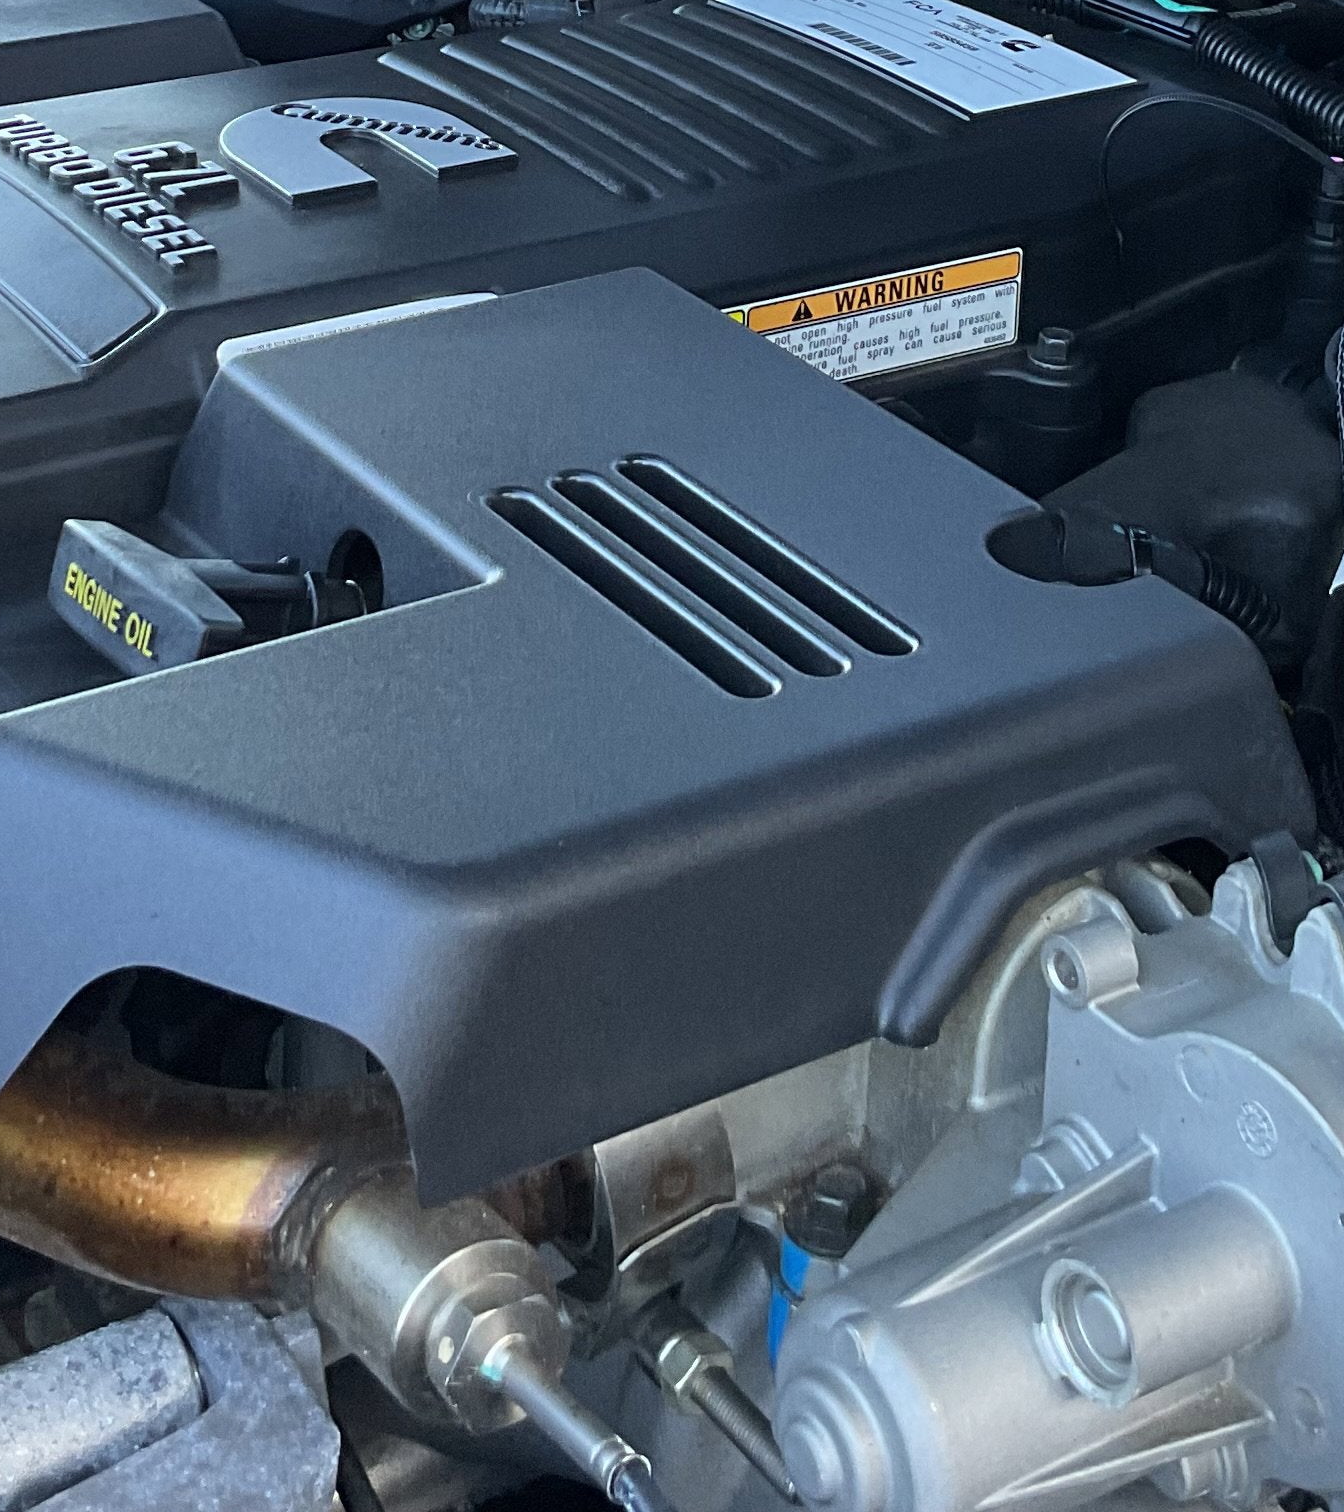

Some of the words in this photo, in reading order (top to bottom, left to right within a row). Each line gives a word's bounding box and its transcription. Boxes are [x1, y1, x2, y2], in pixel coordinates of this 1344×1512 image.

[902, 0, 943, 16] FCA
[270, 101, 506, 151] Cummins
[113, 140, 240, 208] 6.7L
[73, 177, 218, 272] DIESEL
[801, 327, 827, 342] open
[837, 318, 858, 333] high
[869, 307, 913, 328] pressure
[923, 301, 942, 315] fuel
[951, 292, 986, 308] system
[995, 285, 1015, 299] with
[835, 271, 944, 313] WARNING
[796, 345, 843, 362] peration
[854, 335, 889, 350] causes
[899, 327, 920, 342] high
[930, 320, 949, 334] fuel
[958, 310, 1003, 328] pressure.
[809, 333, 850, 349] running.
[838, 349, 857, 365] fuel
[867, 346, 895, 361] spray
[905, 338, 923, 351] can
[933, 330, 962, 344] cause
[972, 320, 1007, 336] serious
[65, 562, 123, 633] ENGINE
[125, 612, 153, 658] OIL
